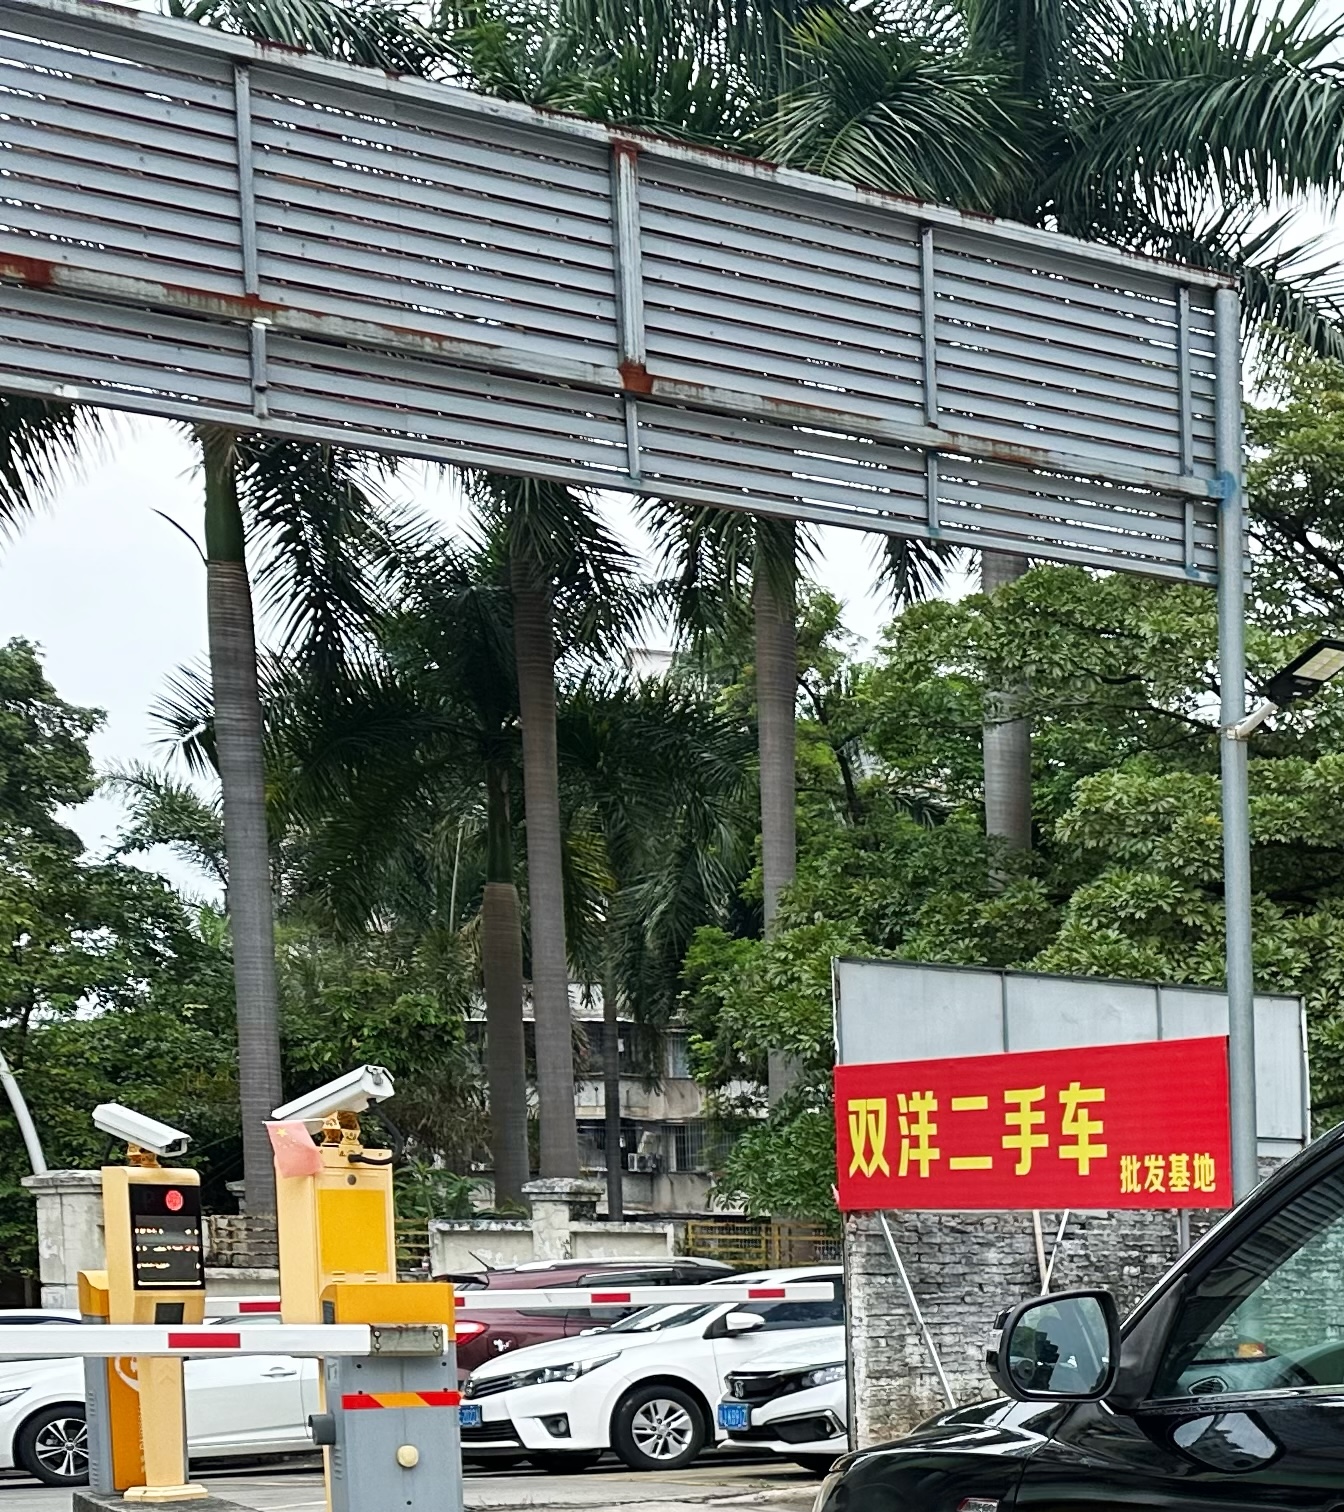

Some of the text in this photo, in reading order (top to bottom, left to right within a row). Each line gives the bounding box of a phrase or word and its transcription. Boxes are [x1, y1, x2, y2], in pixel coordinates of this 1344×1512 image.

[848, 1082, 1108, 1179] 双洋二手车
[1119, 1153, 1217, 1194] 批发基地
